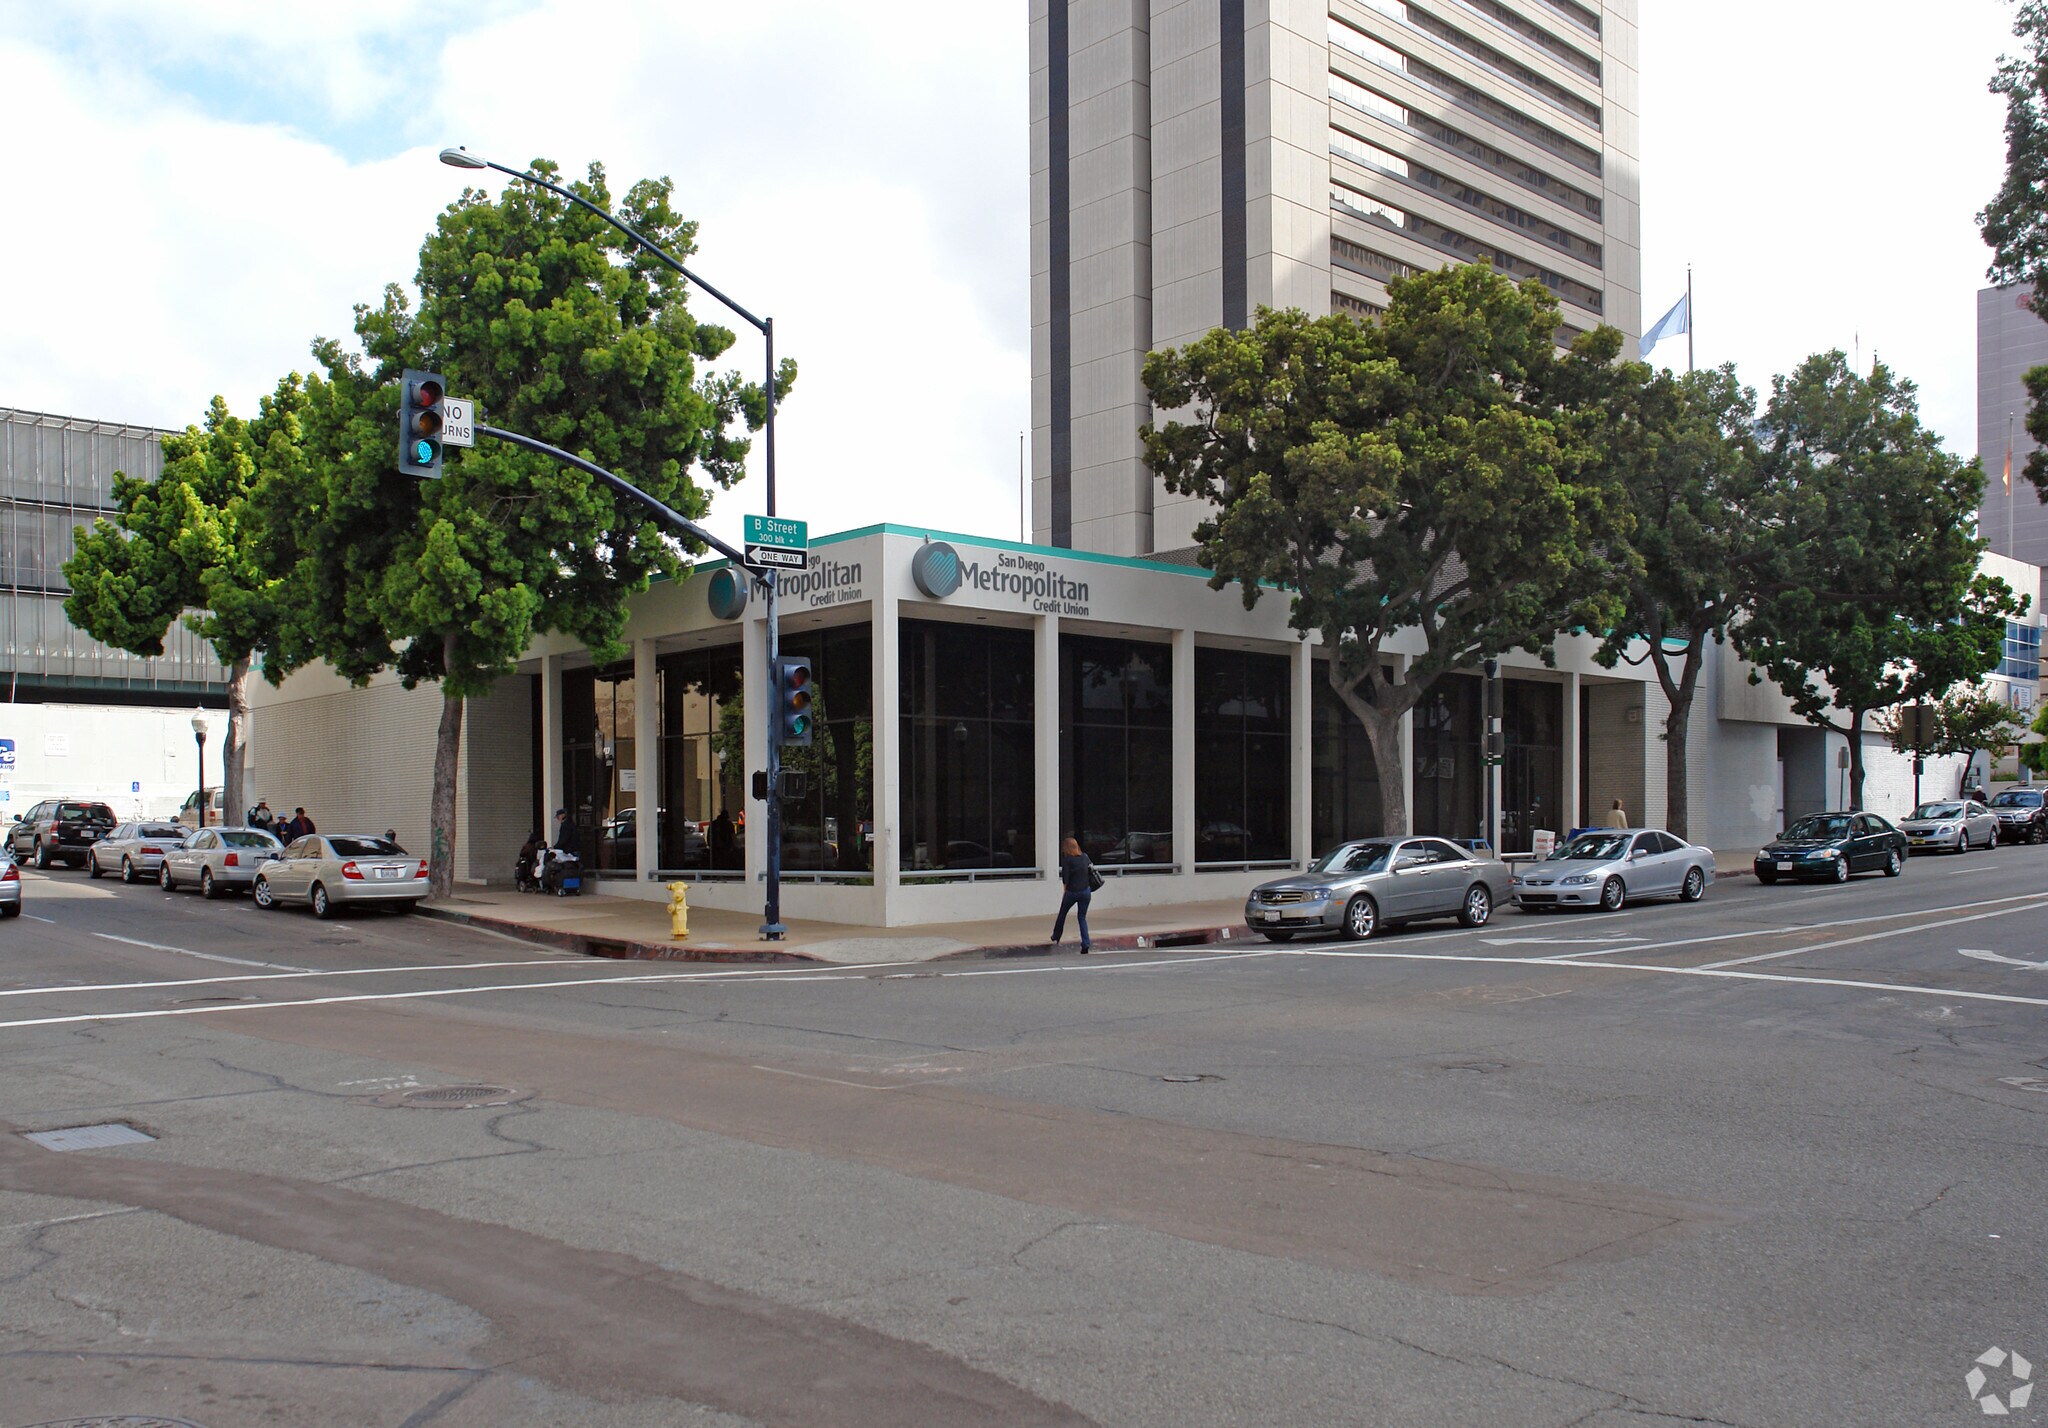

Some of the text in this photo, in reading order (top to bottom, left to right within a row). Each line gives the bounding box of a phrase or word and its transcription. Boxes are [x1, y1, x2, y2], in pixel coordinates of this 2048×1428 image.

[443, 405, 462, 420] NO
[443, 425, 470, 438] URNS
[755, 519, 797, 535] B Street
[759, 533, 773, 543] 300
[761, 552, 799, 563] ONE WAY
[998, 553, 1045, 575] San Diego
[751, 561, 862, 603] Mtropolitan
[960, 561, 1089, 602] Metropolitan
[810, 586, 862, 607] Credit Union
[1033, 599, 1089, 616] Credit Union
